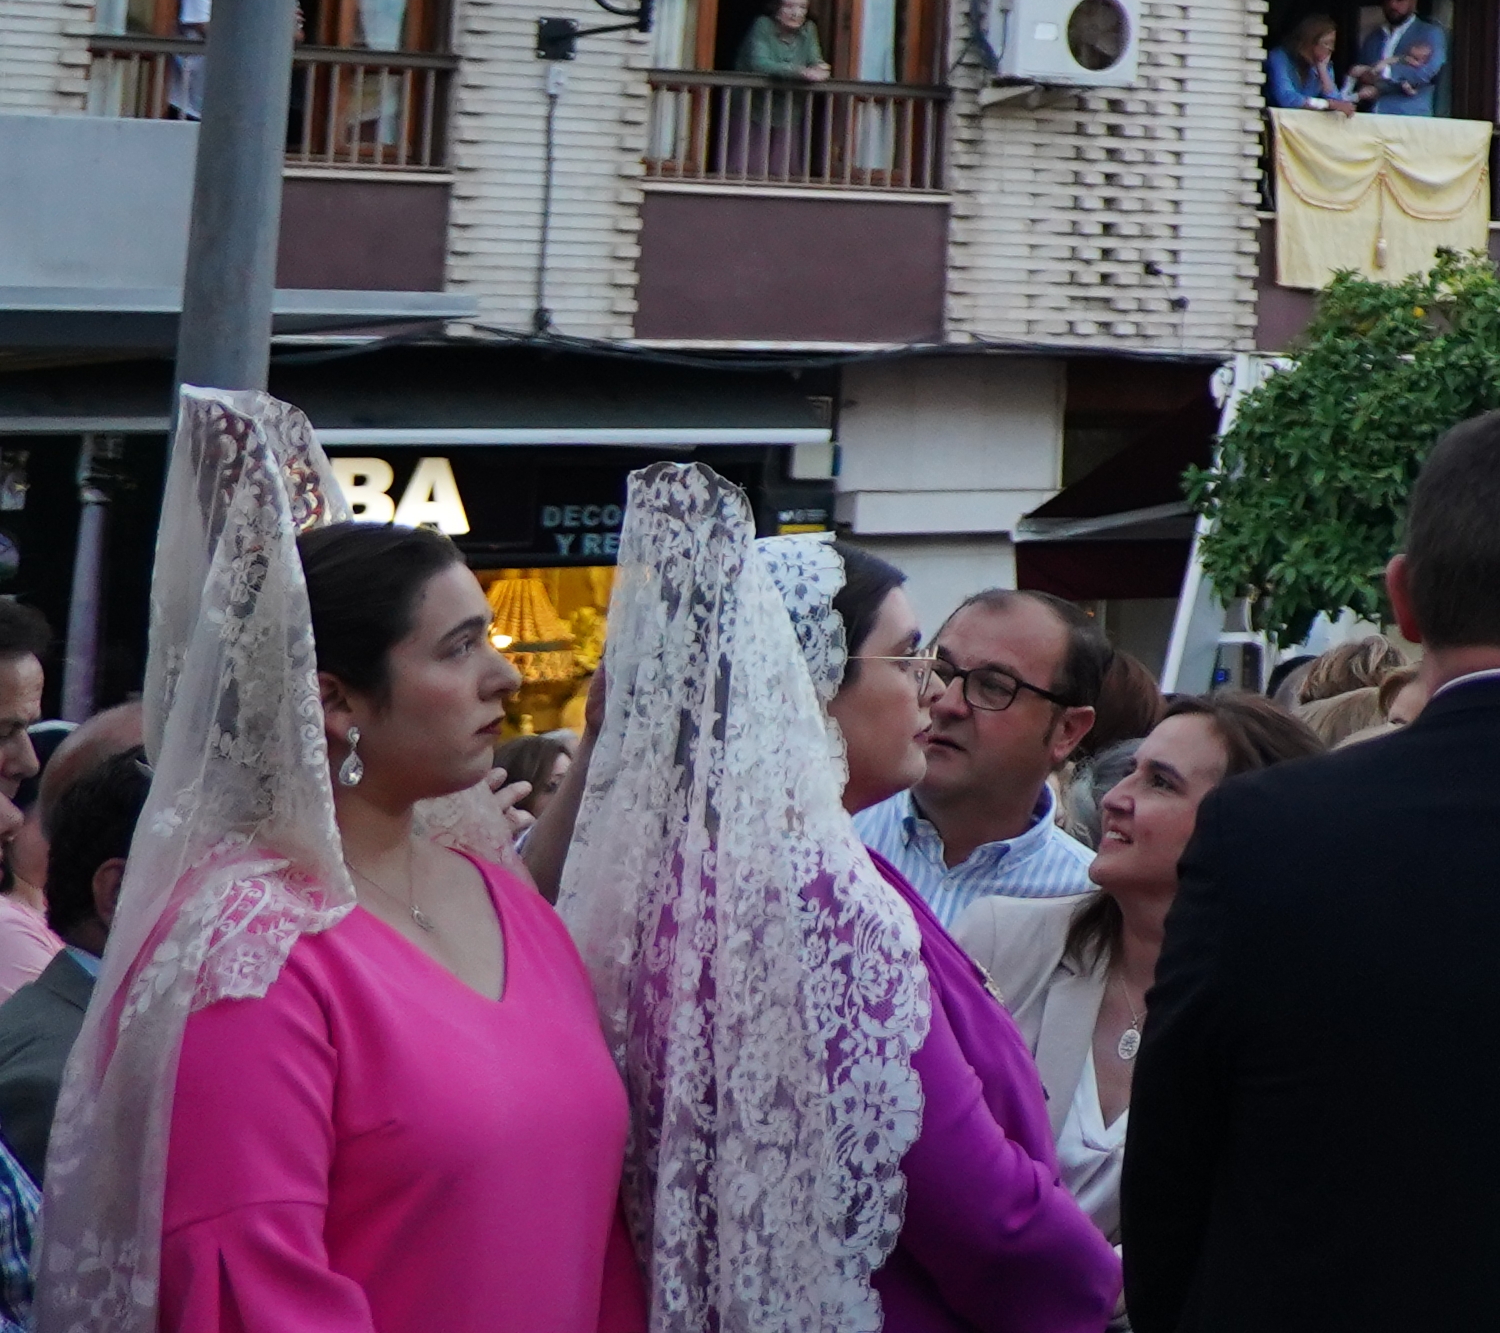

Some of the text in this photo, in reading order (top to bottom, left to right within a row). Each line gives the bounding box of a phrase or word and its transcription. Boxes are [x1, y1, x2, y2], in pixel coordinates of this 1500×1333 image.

[542, 503, 622, 528] DECO
[554, 532, 621, 556] Y RE
